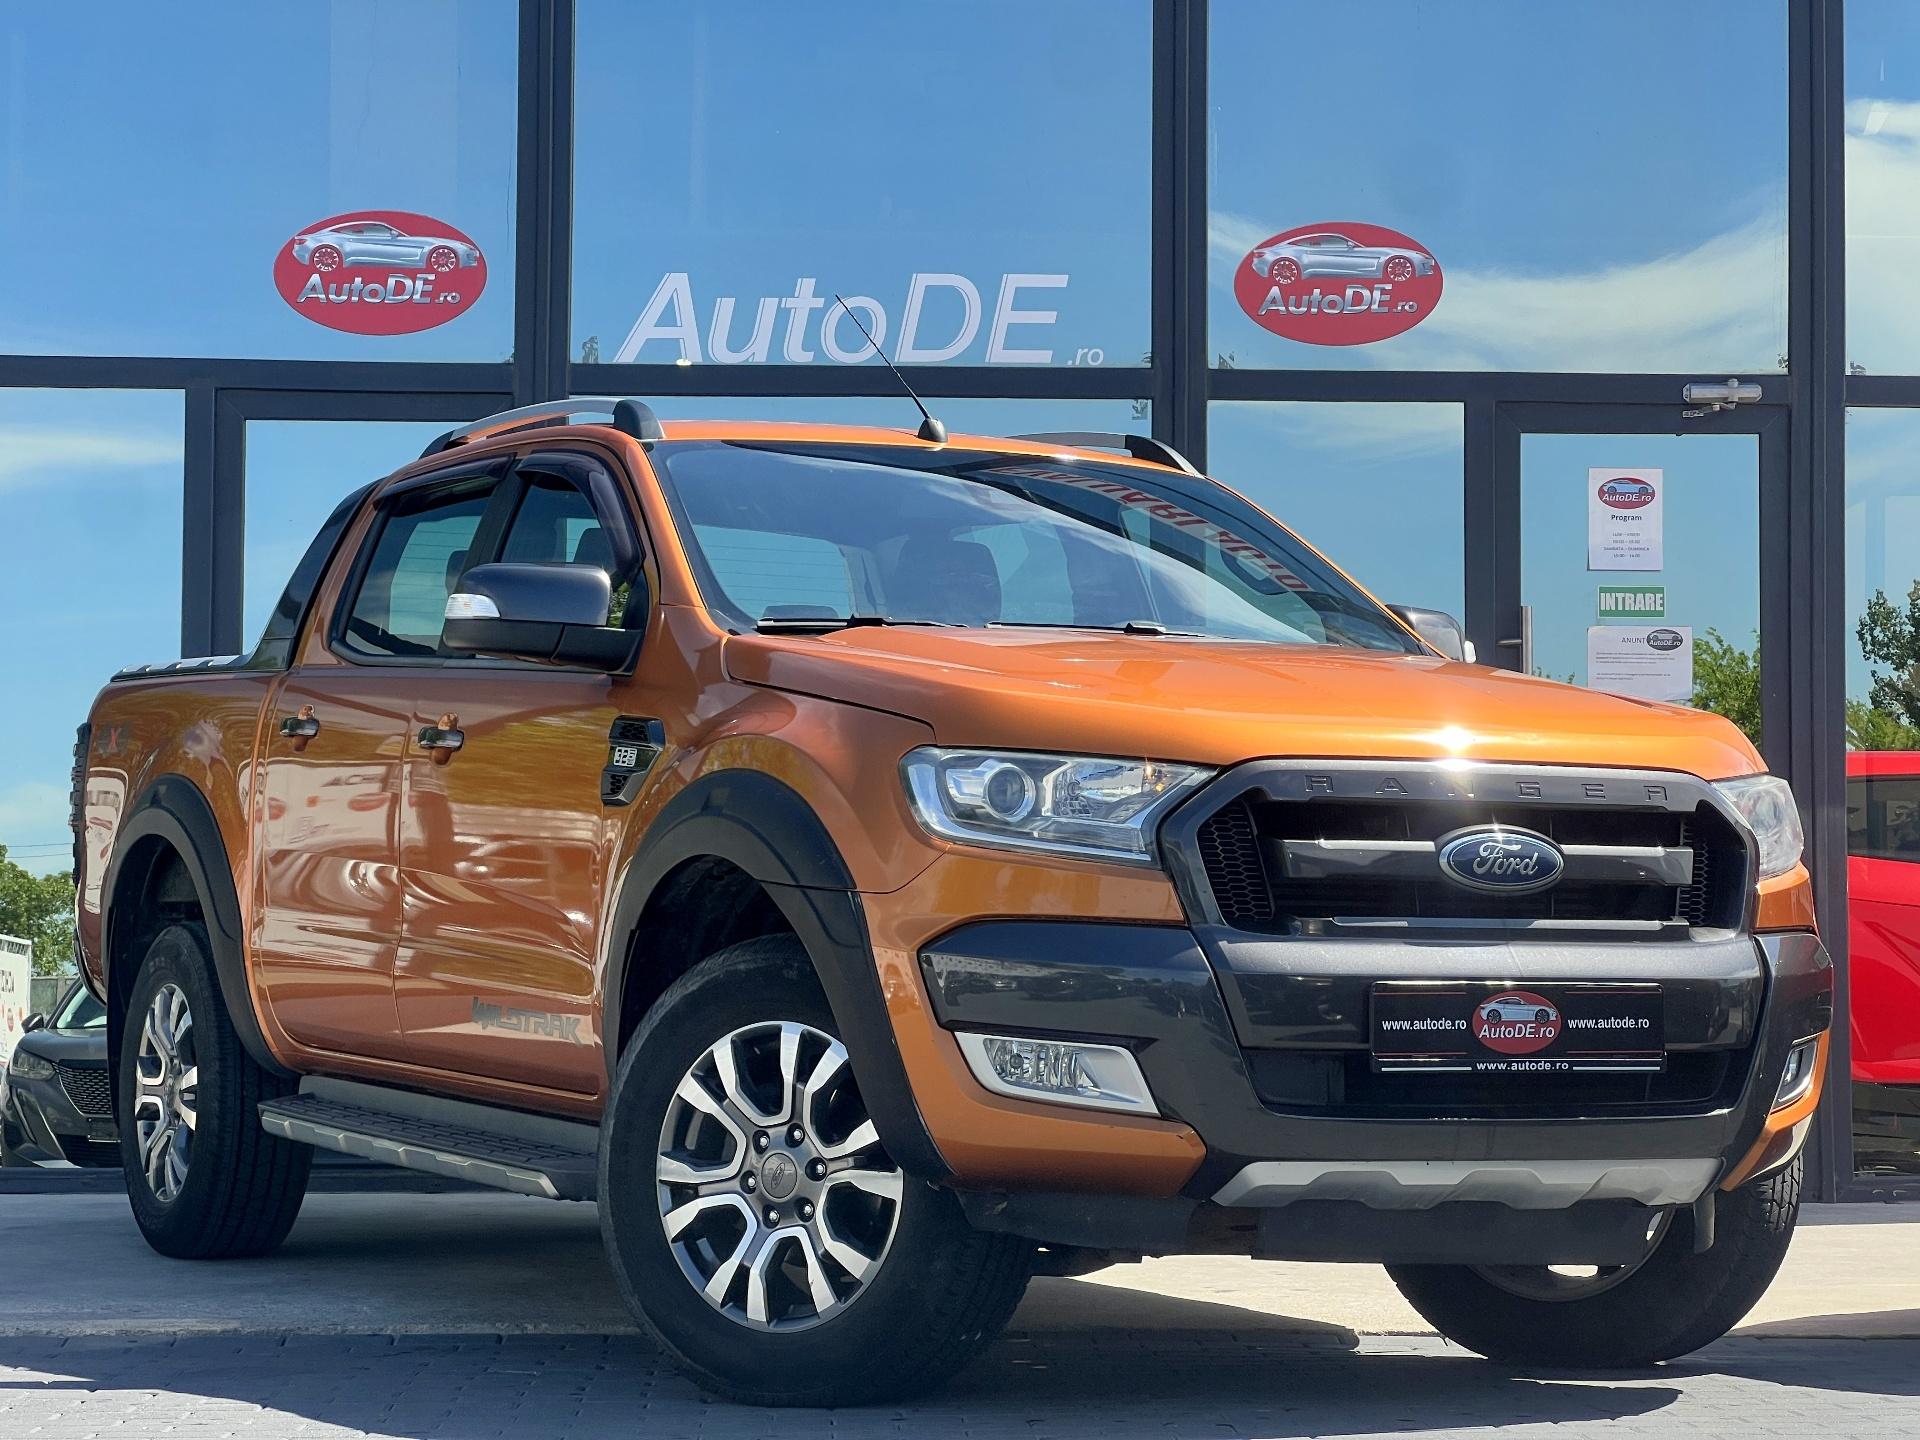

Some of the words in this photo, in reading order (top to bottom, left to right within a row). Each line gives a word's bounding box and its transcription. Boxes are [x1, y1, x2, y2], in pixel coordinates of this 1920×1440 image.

[296, 273, 436, 304] AutoDE
[1257, 284, 1393, 315] AutoDE
[614, 272, 1069, 364] AutoDE
[1611, 514, 1642, 522] Program
[1600, 592, 1664, 612] INTRARE
[1472, 840, 1538, 877] Ford
[1382, 1017, 1467, 1031] www.autode.ro
[1478, 1023, 1555, 1040] AutoDE.ro
[1568, 1015, 1650, 1029] www.autode.ro
[1476, 1060, 1569, 1071] www.autode.ro
